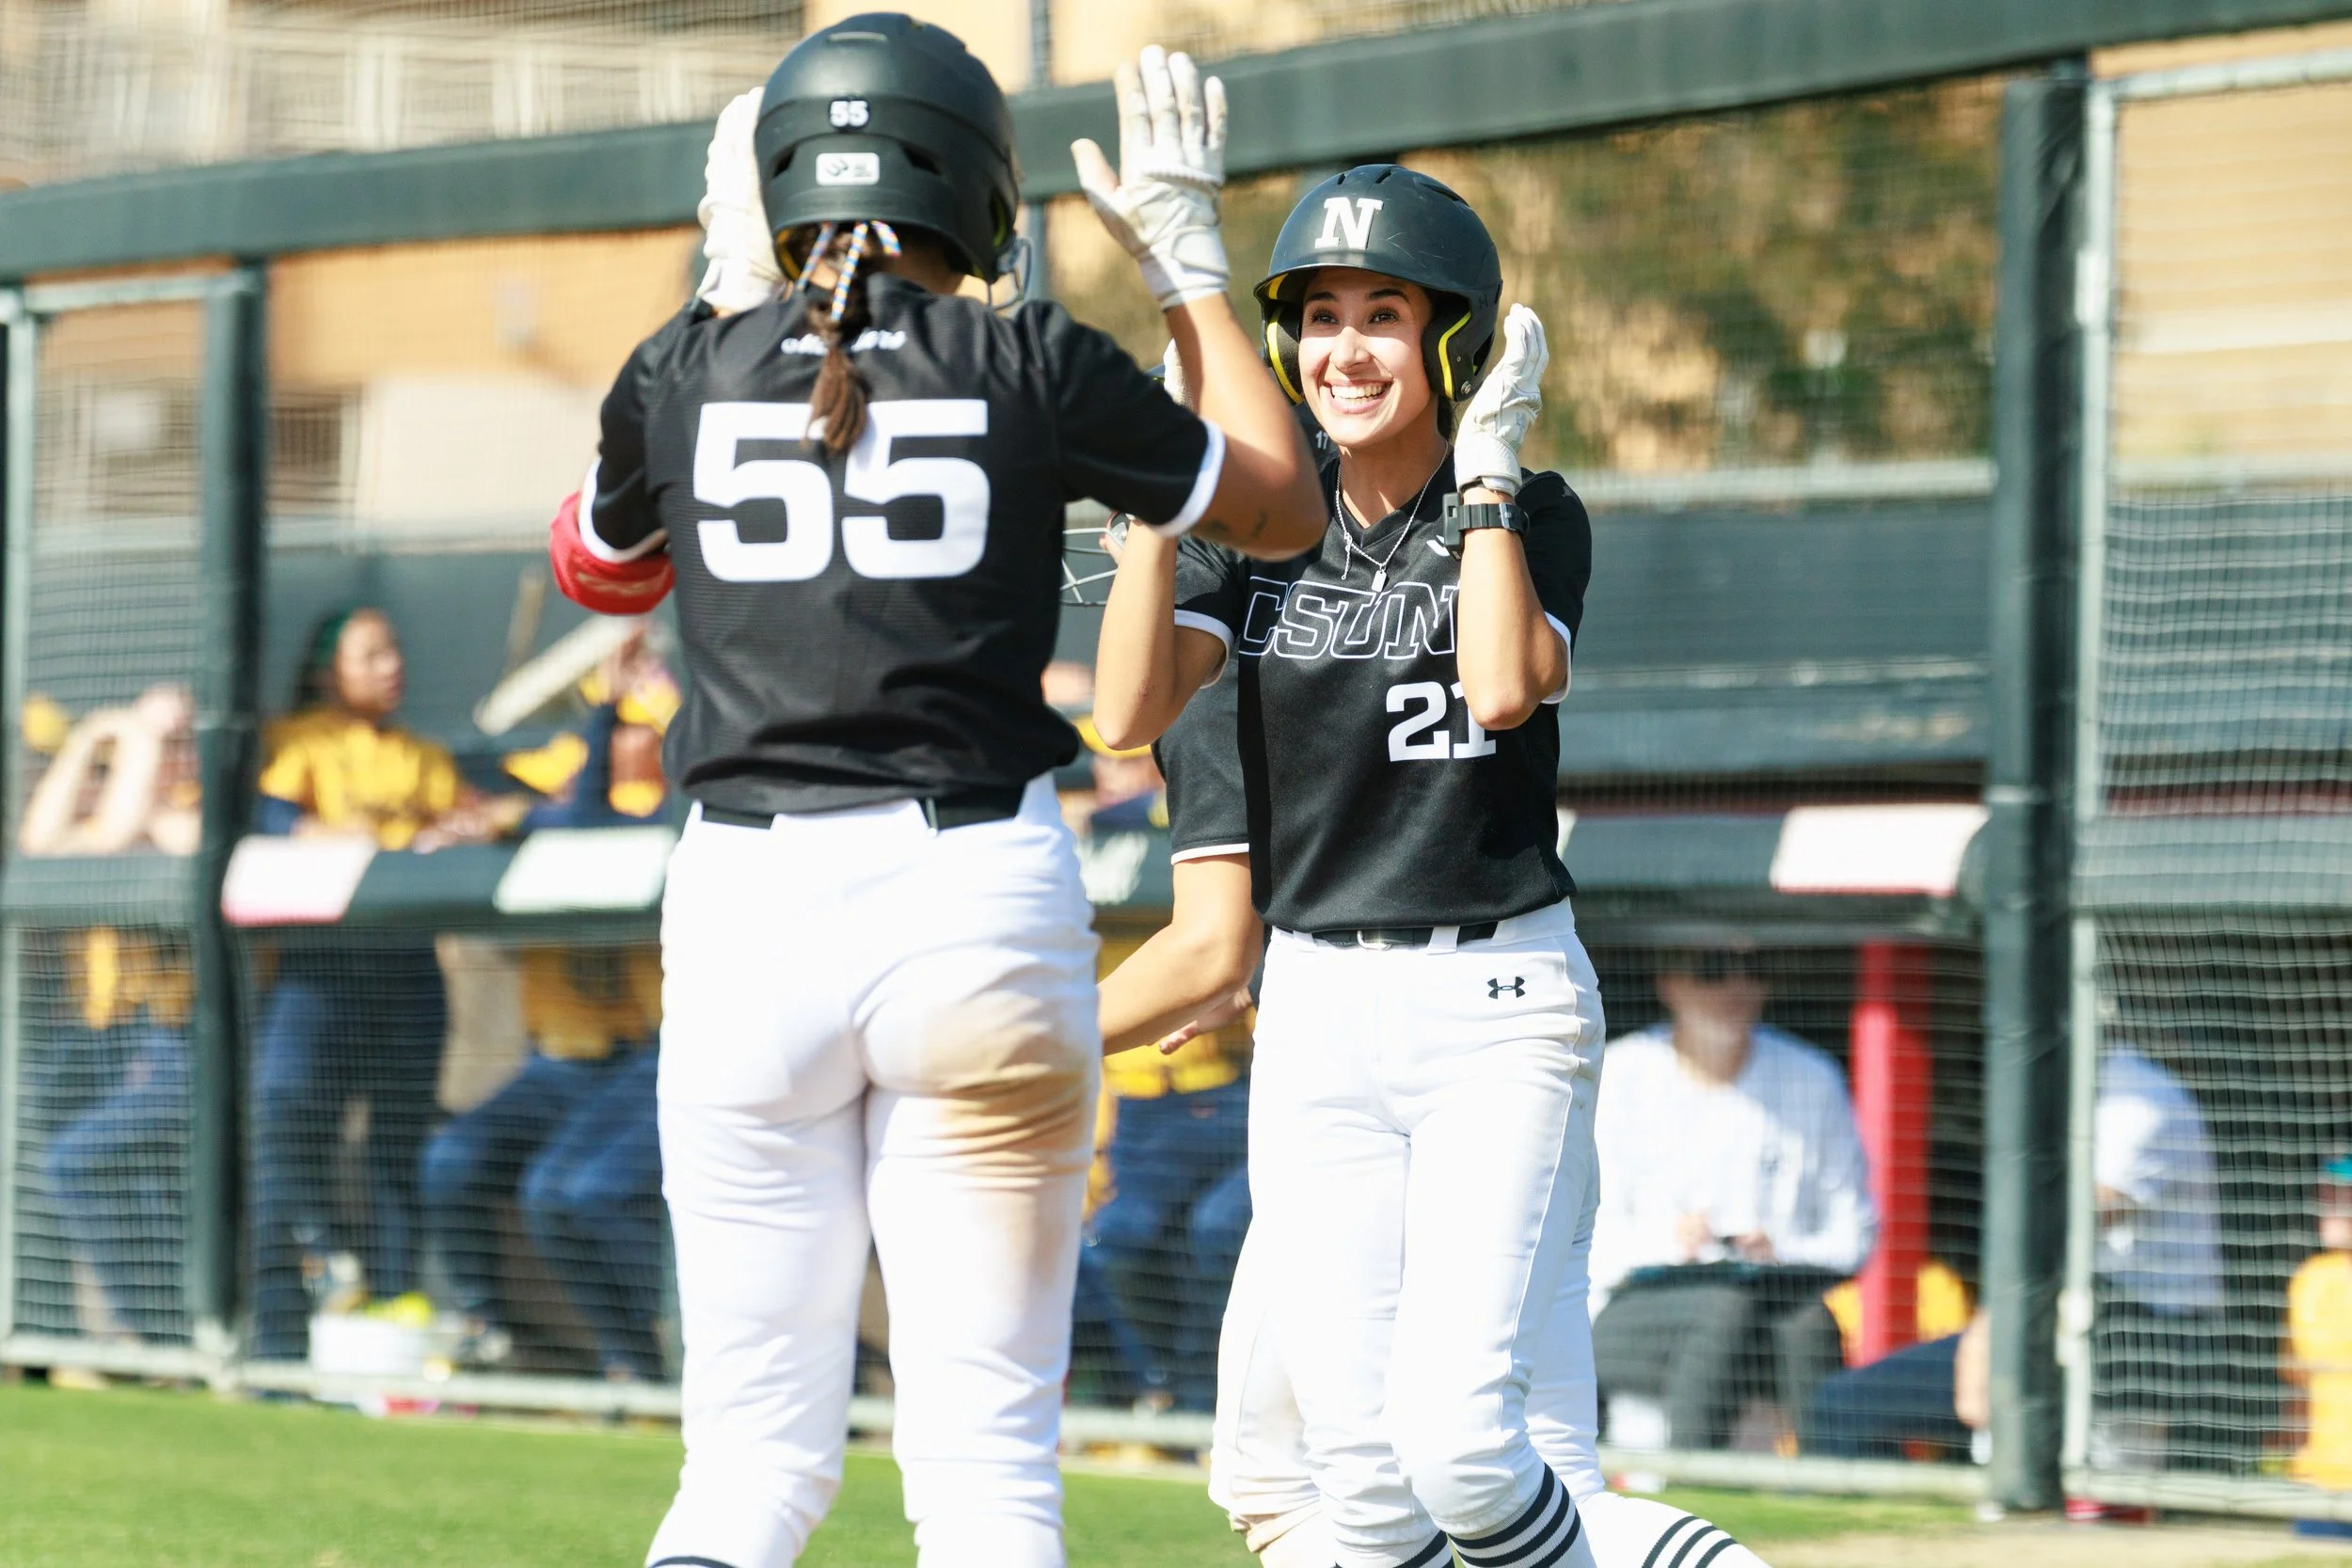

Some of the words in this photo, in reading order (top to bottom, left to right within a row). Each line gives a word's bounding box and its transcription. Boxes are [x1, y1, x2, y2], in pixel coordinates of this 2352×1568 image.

[829, 99, 869, 127] 55
[1314, 197, 1384, 250] N
[693, 399, 991, 582] 55
[1238, 576, 1461, 660] CSUN
[1386, 681, 1497, 762] 21
